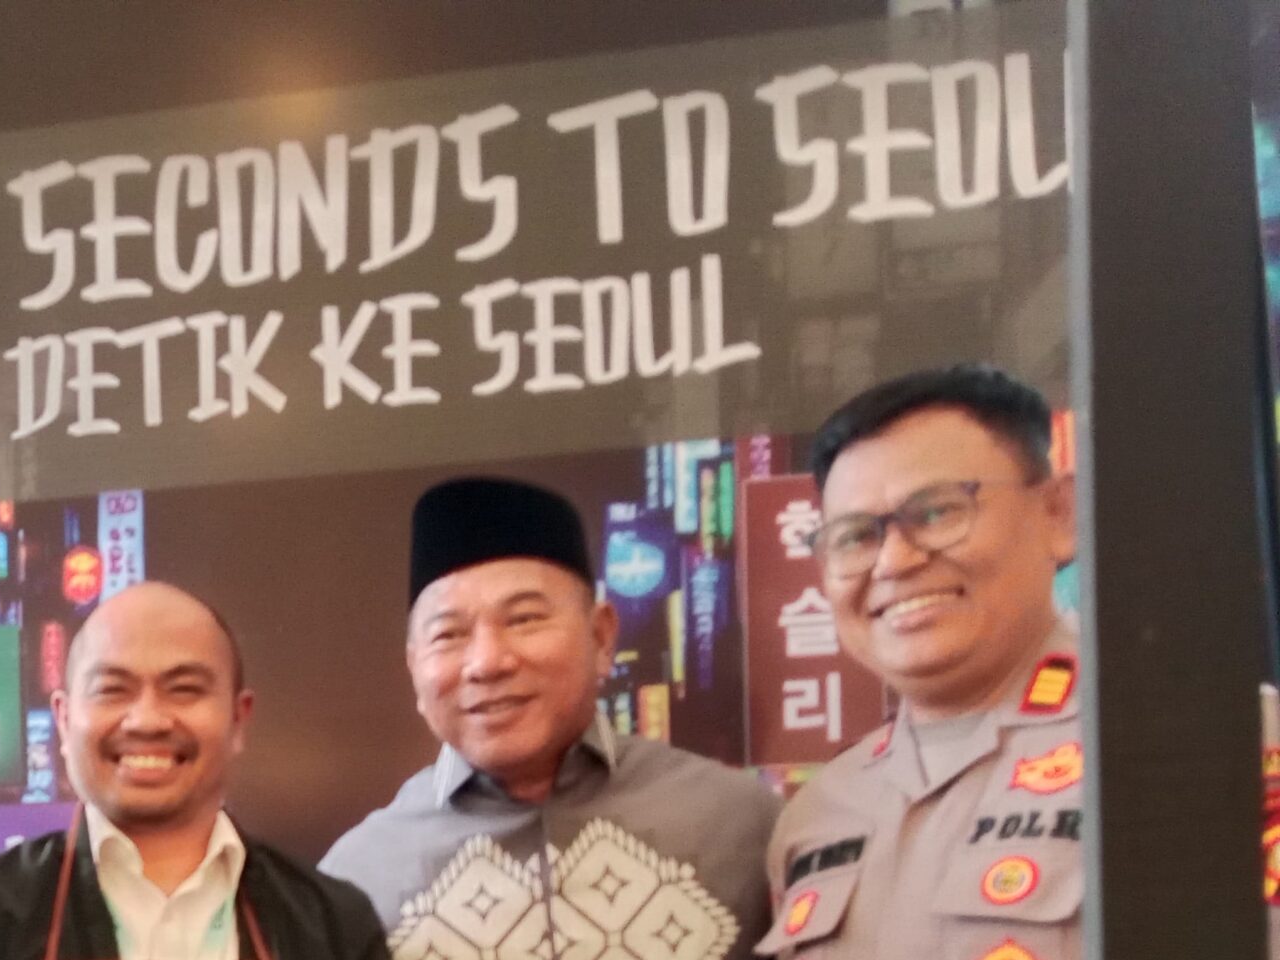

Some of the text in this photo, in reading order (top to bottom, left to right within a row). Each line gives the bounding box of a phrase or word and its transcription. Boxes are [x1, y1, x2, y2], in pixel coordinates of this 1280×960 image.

[6, 103, 519, 311] SECONDS
[546, 88, 730, 245] TO
[4, 253, 762, 441] DETIK KE SEOUL
